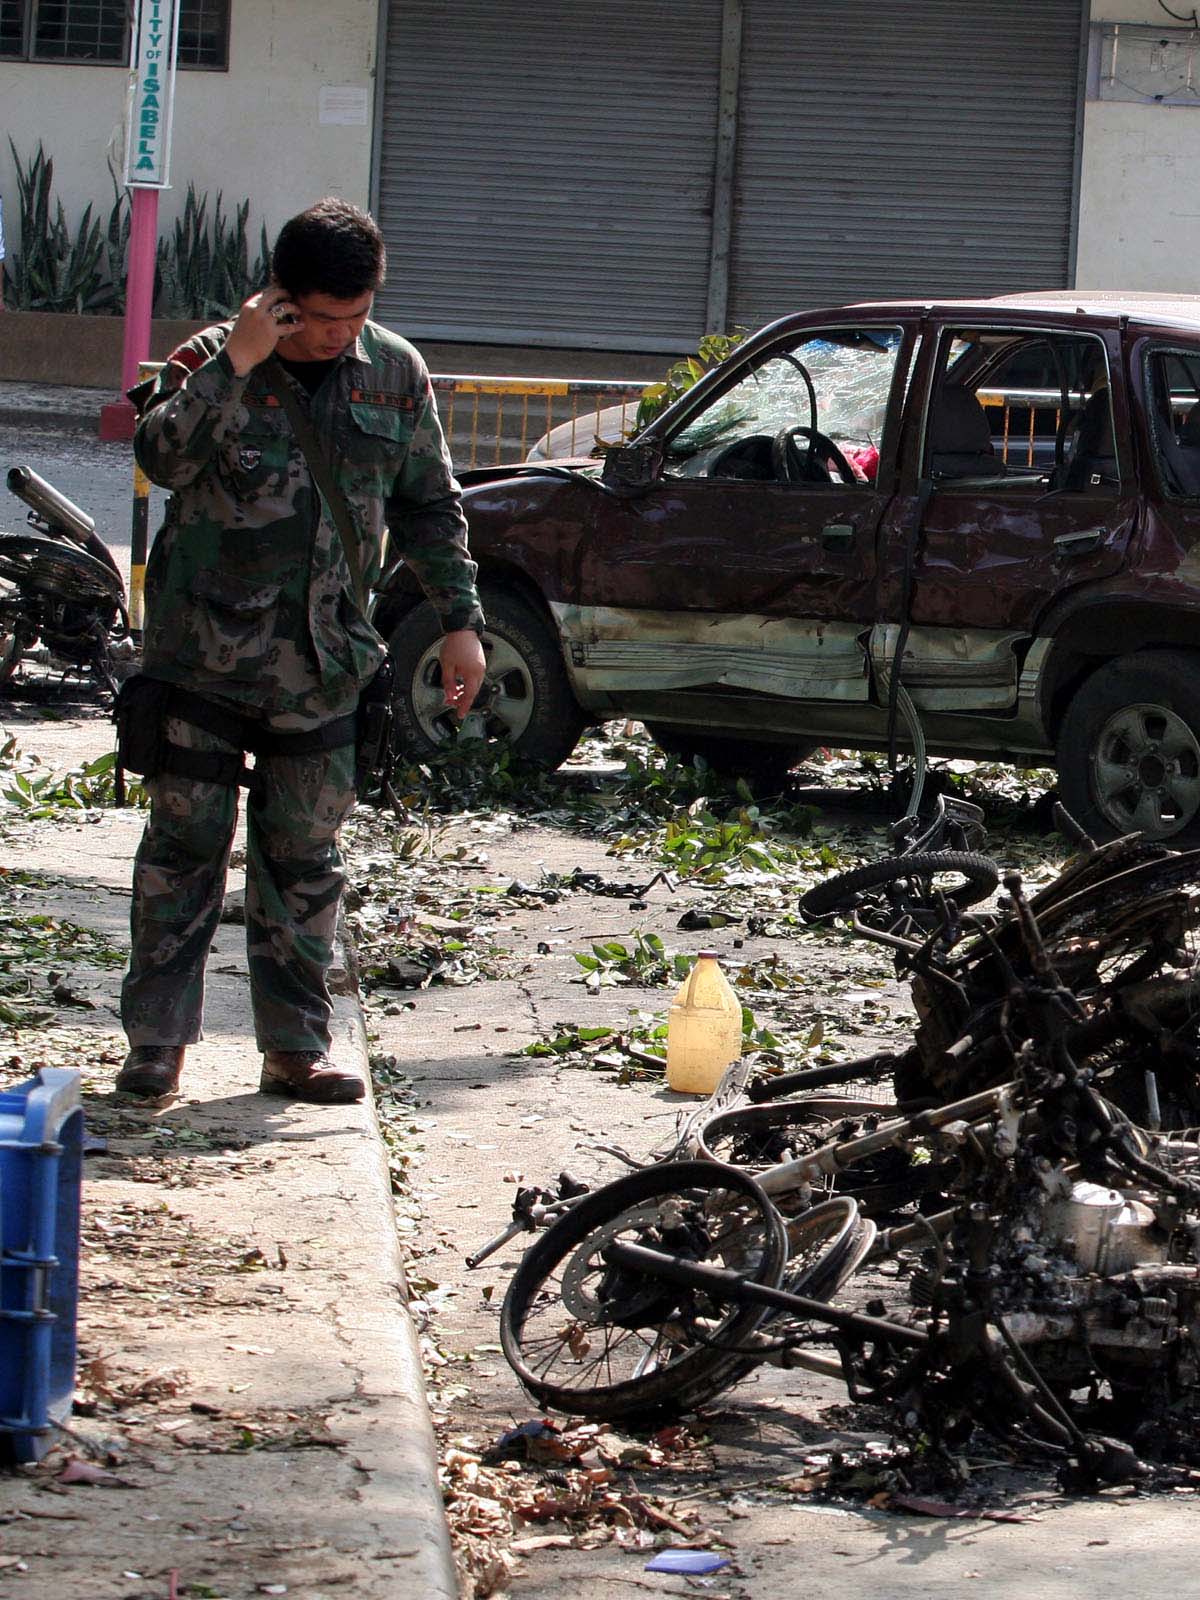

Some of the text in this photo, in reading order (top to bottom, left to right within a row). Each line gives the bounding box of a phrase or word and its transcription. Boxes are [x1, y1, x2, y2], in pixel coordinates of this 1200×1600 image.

[135, 0, 163, 170] ITY OF ISABELA
